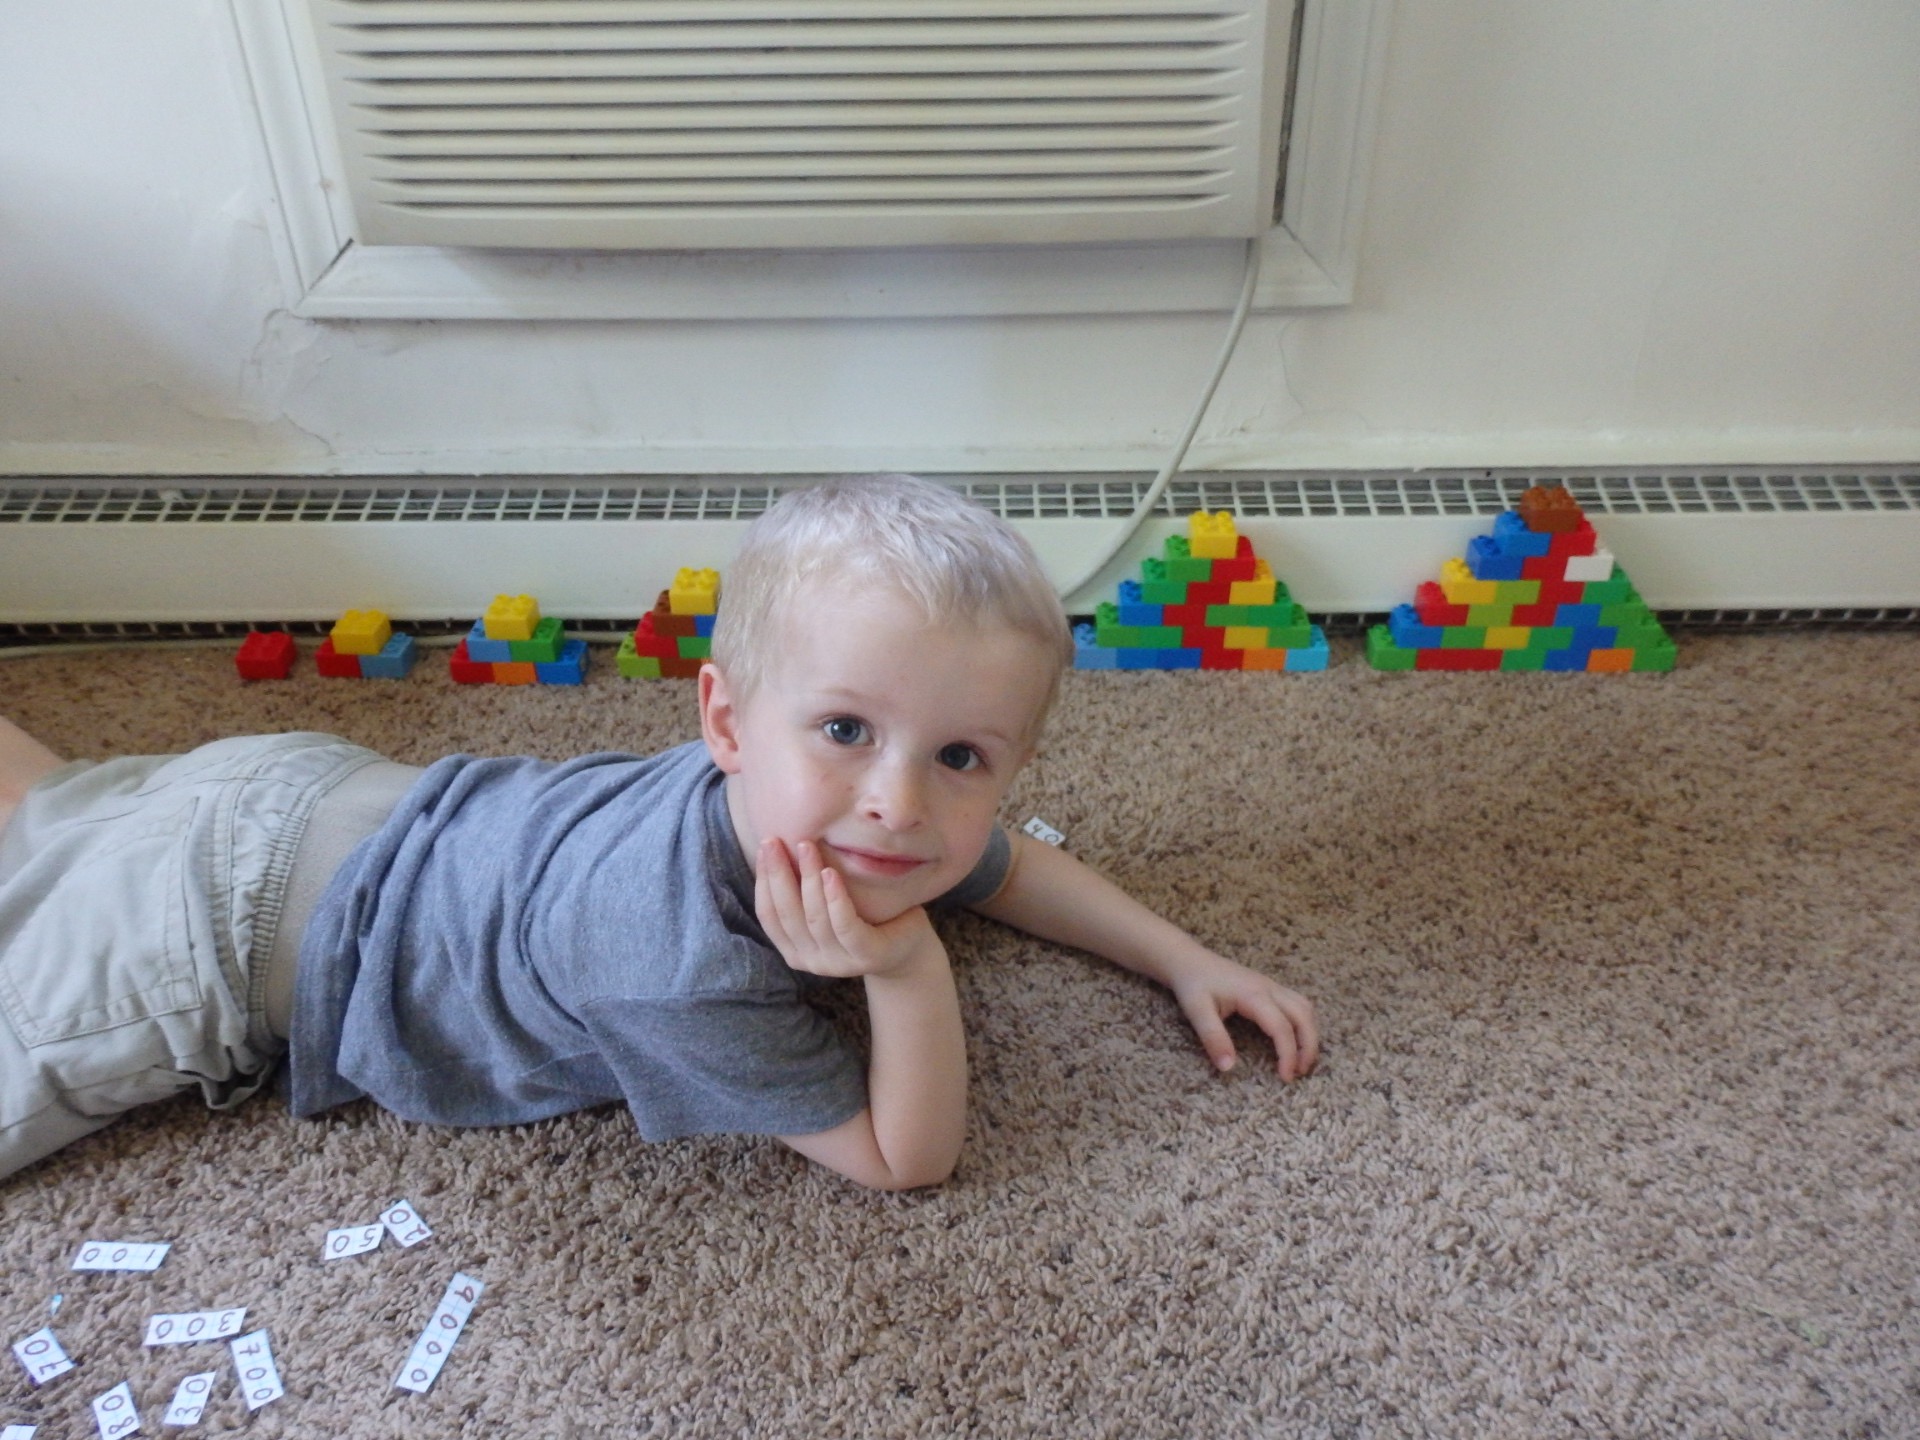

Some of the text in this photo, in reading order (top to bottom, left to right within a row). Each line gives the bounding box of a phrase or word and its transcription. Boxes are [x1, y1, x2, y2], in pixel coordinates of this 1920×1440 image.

[332, 1227, 377, 1254] 50
[388, 1208, 428, 1242] 20
[82, 1247, 156, 1264] 100
[155, 1311, 237, 1339] 300
[238, 1341, 275, 1401] 700
[100, 1393, 136, 1436] 80
[174, 1377, 208, 1418] 30
